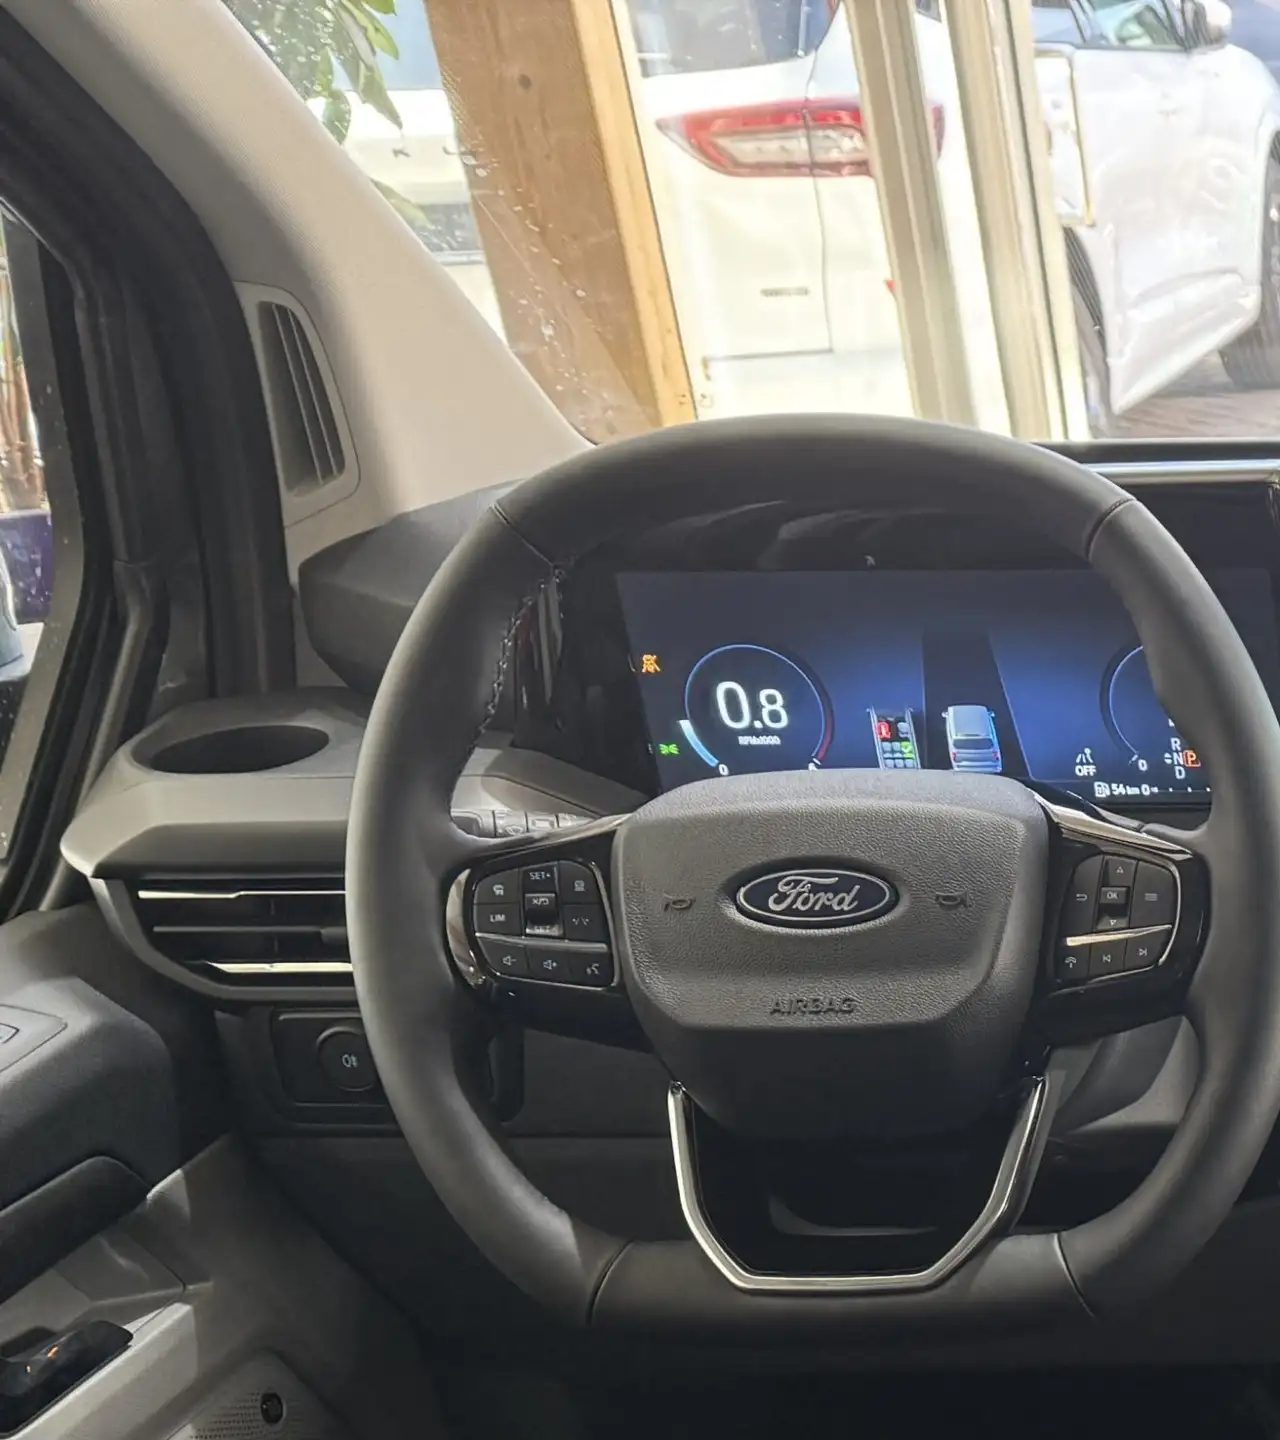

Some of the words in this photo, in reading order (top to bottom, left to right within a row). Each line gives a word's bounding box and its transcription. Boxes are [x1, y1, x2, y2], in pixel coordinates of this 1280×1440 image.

[716, 680, 789, 729] 0.8
[1171, 737, 1181, 751] R
[1075, 765, 1097, 776] OFF
[1175, 766, 1186, 780] D
[767, 875, 861, 912] Ford
[1107, 891, 1118, 900] OK
[490, 913, 506, 923] LIM
[769, 997, 857, 1015] AIRBAG
